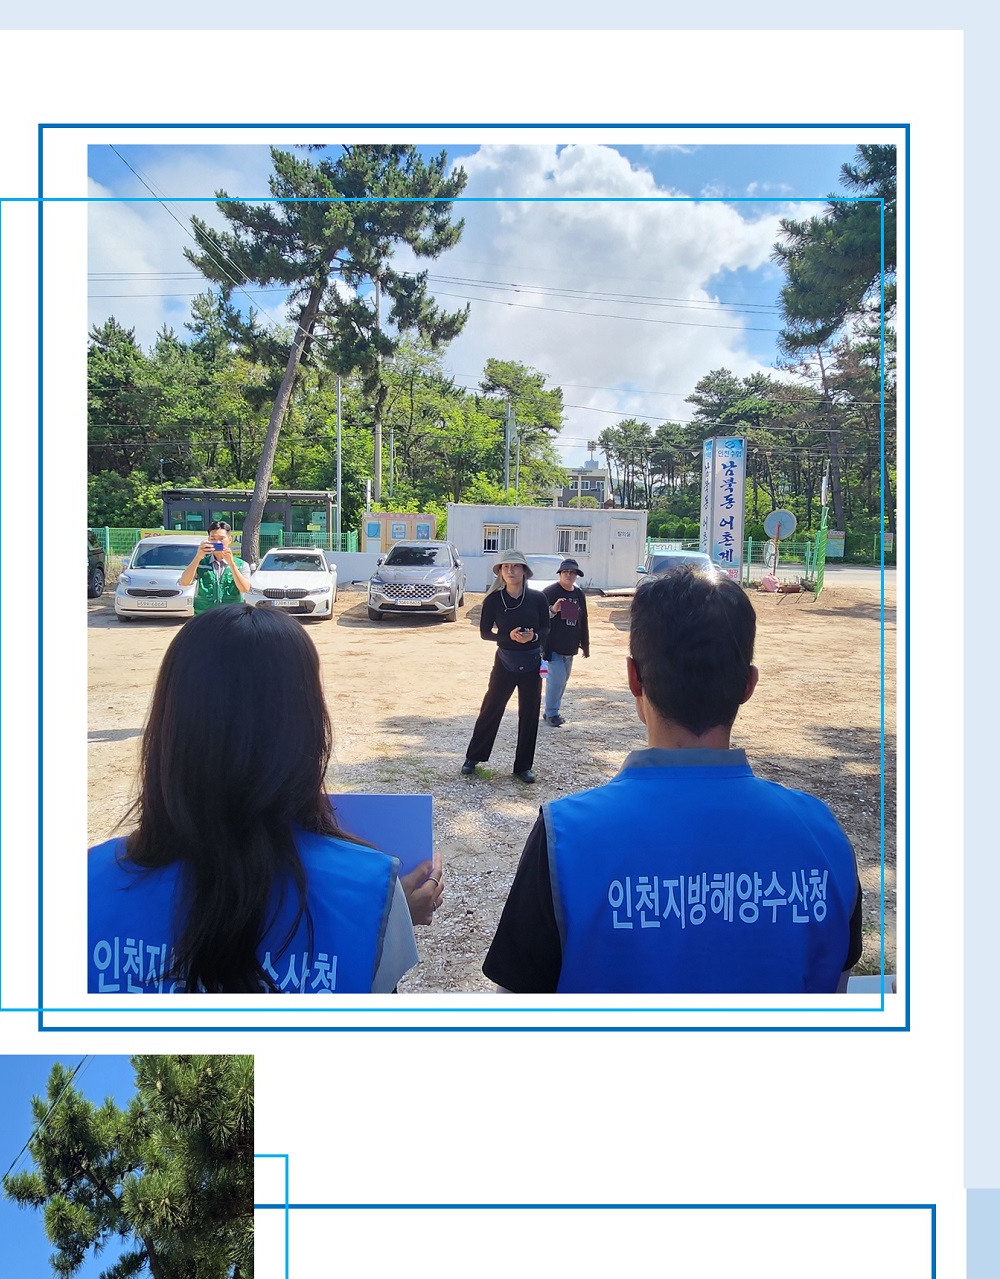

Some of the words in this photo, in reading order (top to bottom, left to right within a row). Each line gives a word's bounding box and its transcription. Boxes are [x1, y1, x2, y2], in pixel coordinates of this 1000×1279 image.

[720, 461, 737, 509] 남북동
[718, 516, 735, 562] 어촌계
[607, 869, 829, 929] 인천지방해양수산청
[93, 937, 338, 993] 인천지산청
